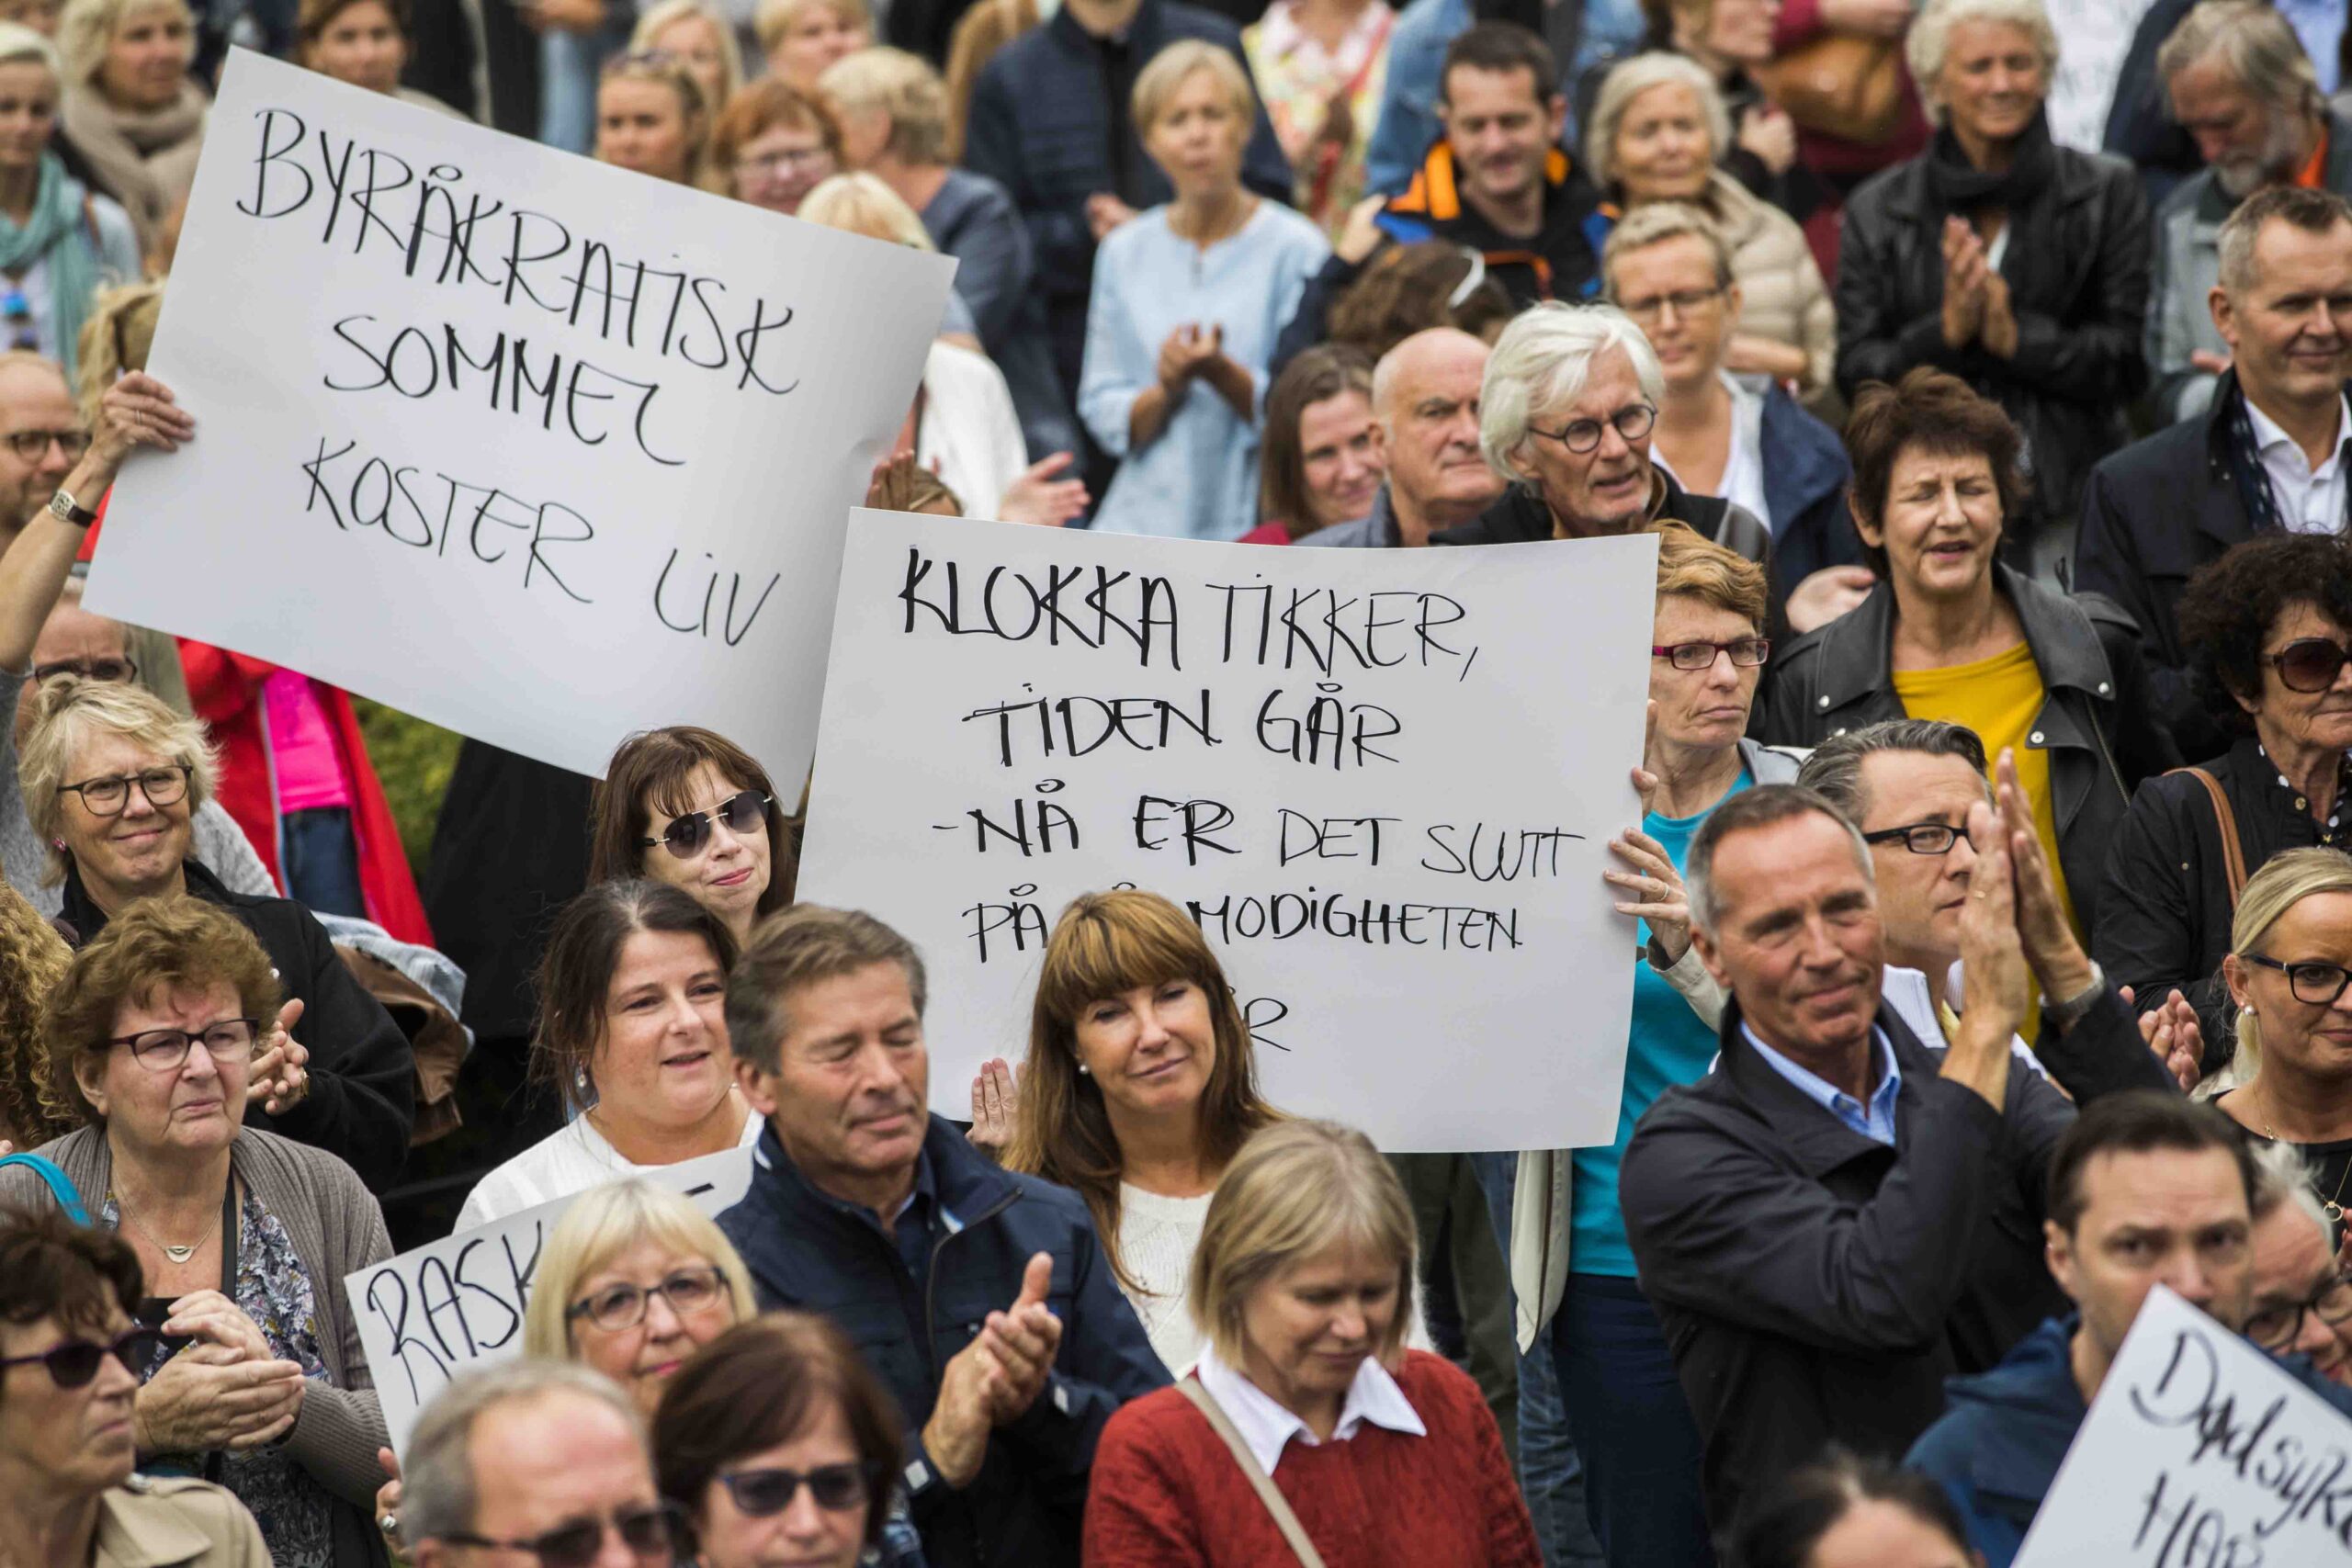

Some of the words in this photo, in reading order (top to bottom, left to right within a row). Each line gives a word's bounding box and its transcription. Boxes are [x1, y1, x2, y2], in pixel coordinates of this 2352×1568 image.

[301, 436, 594, 604] KOSTER
[898, 547, 1181, 671] KLOKKA
[1257, 682, 1401, 771] GÅR
[1133, 793, 1242, 866] ER
[1278, 808, 1402, 867] DET
[962, 883, 1048, 964] PÅ
